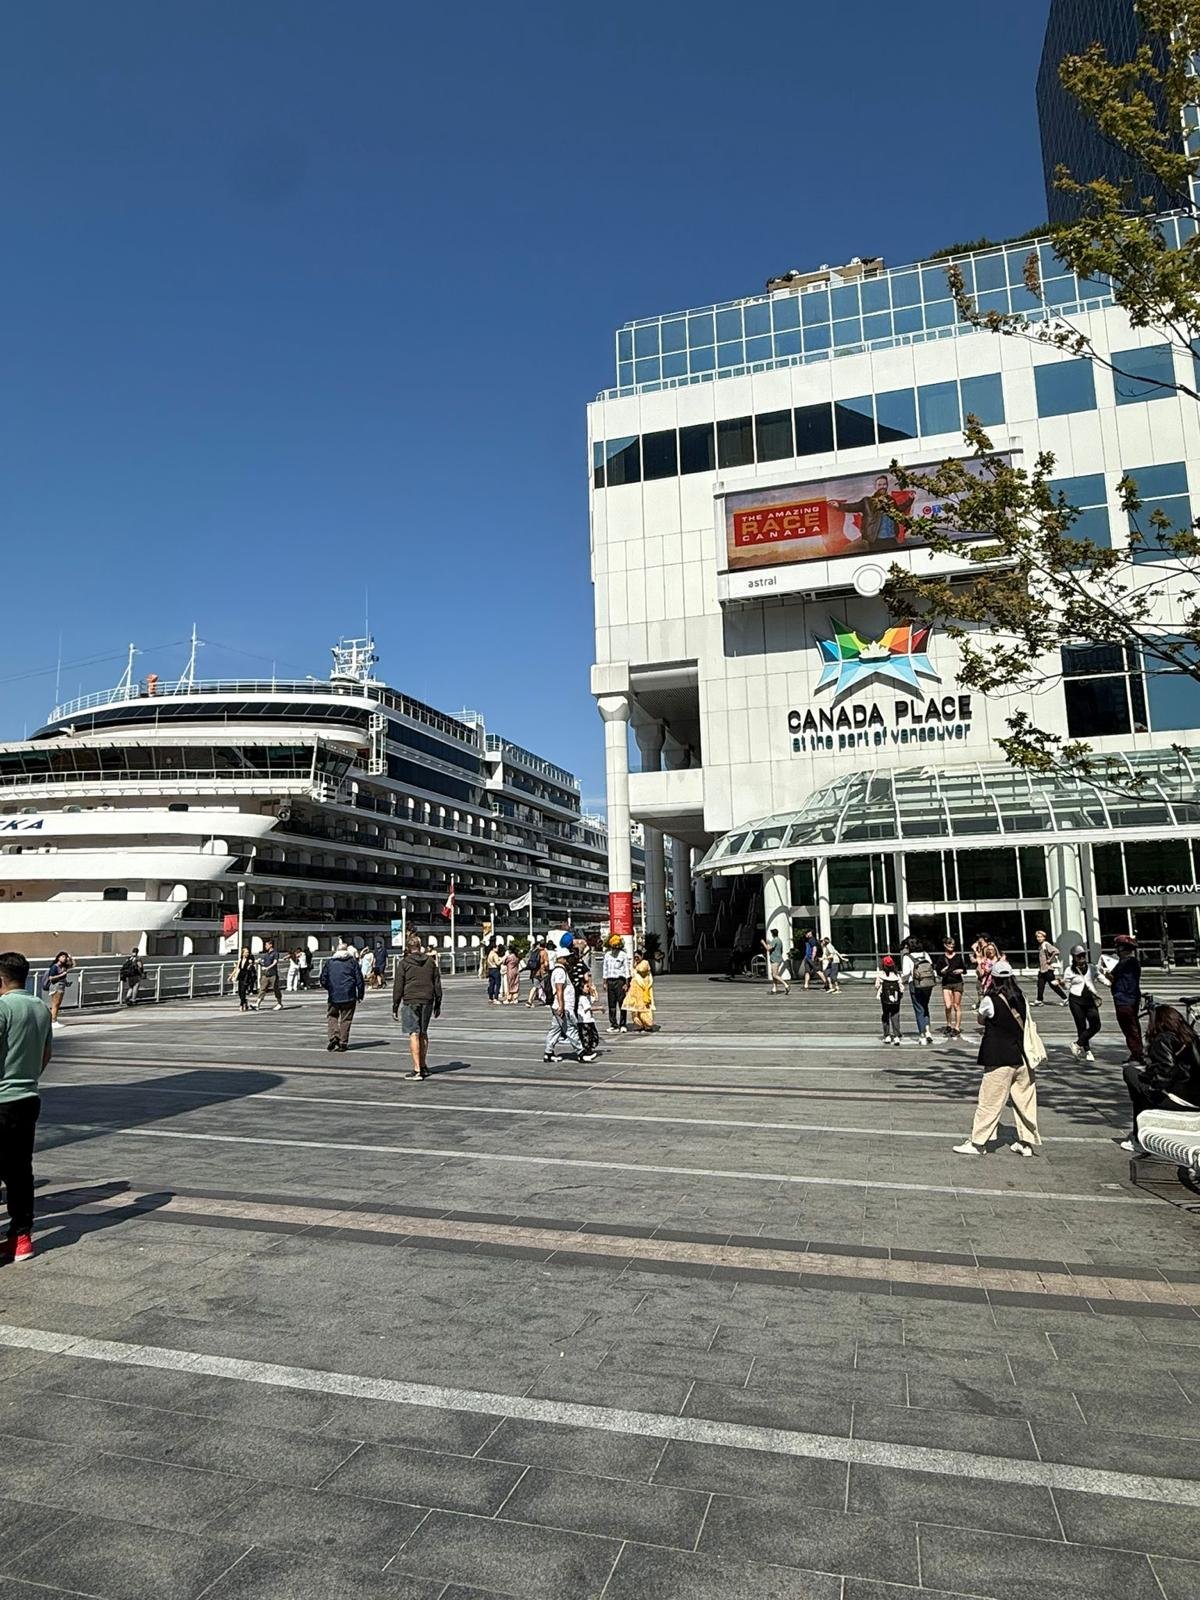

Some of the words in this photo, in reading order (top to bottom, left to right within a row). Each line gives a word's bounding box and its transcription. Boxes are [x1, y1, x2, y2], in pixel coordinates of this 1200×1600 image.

[742, 514, 762, 522] THE
[768, 506, 820, 518] AMAZING
[742, 513, 820, 535] RACE
[742, 526, 821, 541] CANADA
[748, 575, 777, 588] astral
[788, 703, 884, 733] CANADA
[895, 695, 972, 726] PLACE
[793, 735, 806, 752] at
[811, 734, 833, 751] the
[838, 730, 869, 752] port
[874, 726, 887, 746] of
[891, 723, 971, 744] vancouver
[0, 818, 44, 830] KA
